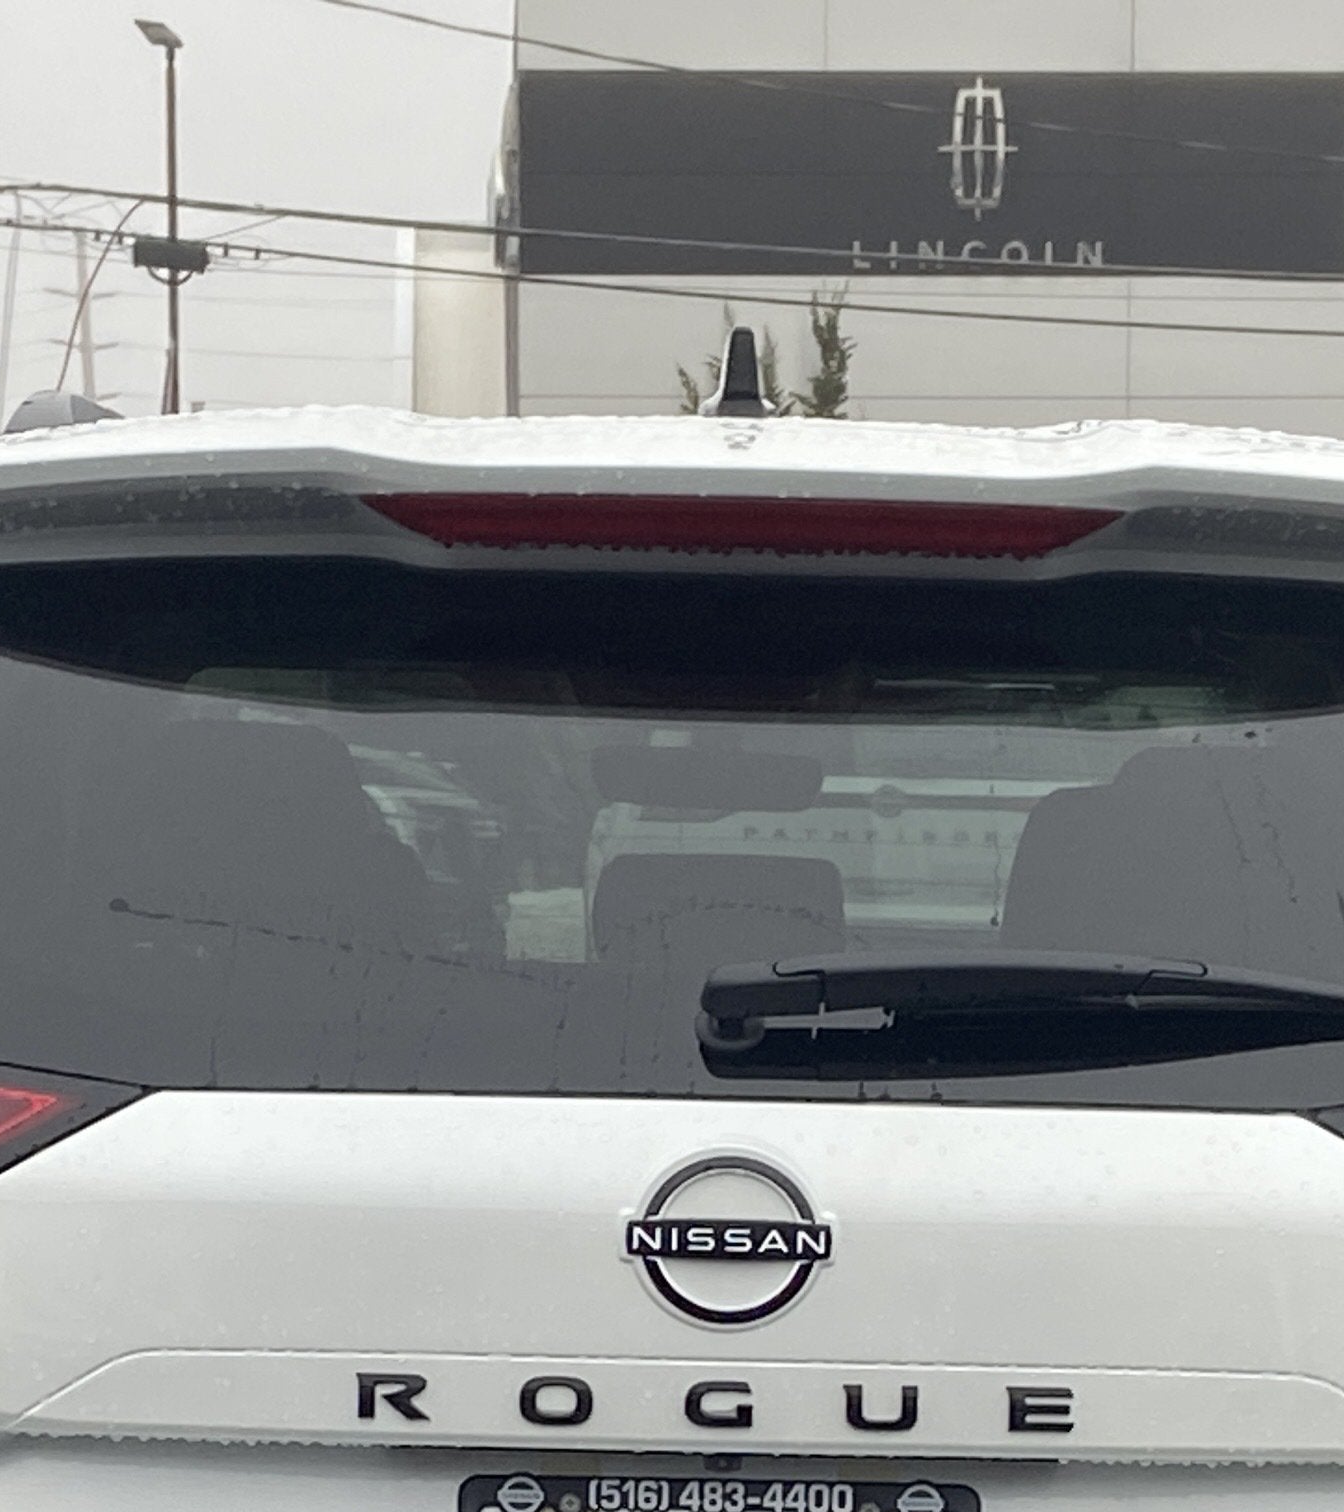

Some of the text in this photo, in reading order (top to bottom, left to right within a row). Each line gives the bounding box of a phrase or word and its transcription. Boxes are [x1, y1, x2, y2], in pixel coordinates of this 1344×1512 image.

[852, 240, 1103, 270] LINCOLN
[631, 1226, 827, 1256] NISSAN
[356, 1372, 1075, 1433] ROGUE
[587, 1478, 670, 1512] (516)
